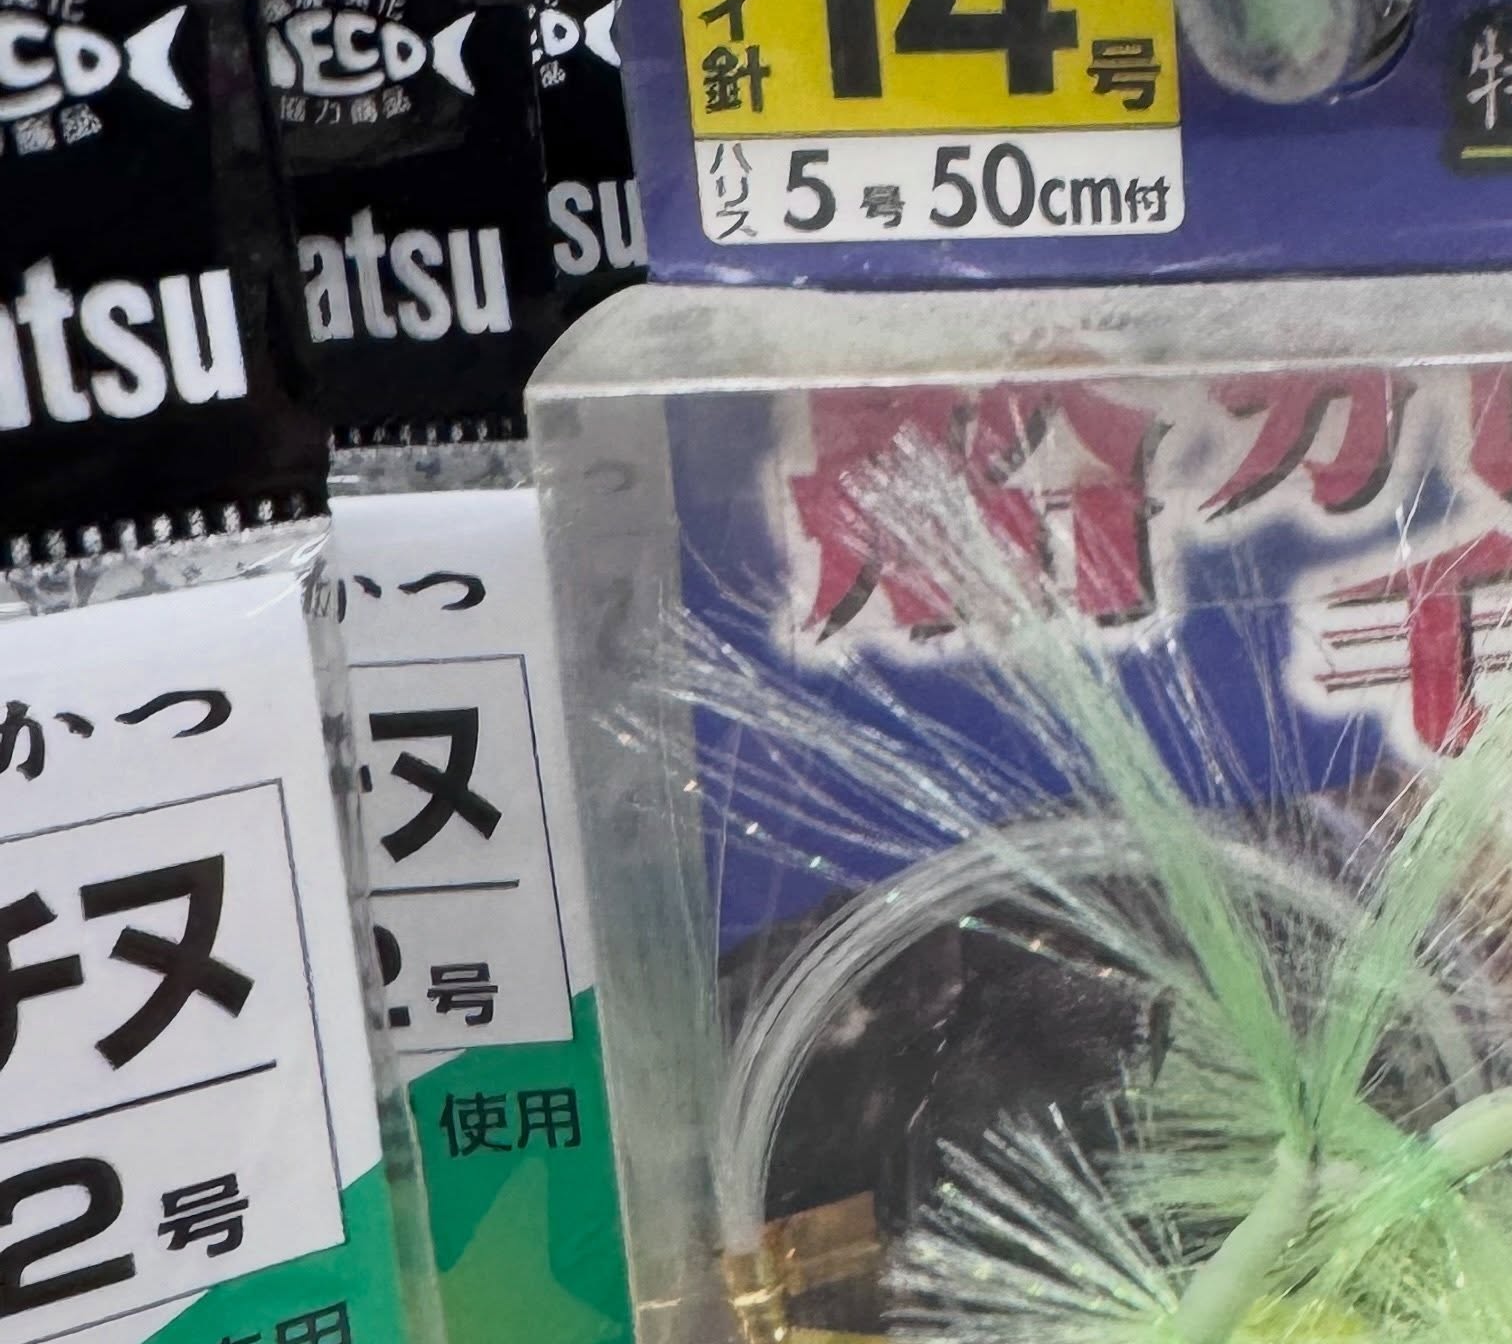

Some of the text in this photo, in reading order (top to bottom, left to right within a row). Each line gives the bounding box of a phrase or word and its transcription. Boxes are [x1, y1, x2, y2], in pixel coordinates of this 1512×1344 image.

[709, 143, 758, 241] ハリス
[361, 706, 502, 863] ヌ
[439, 1086, 583, 1158] 使用
